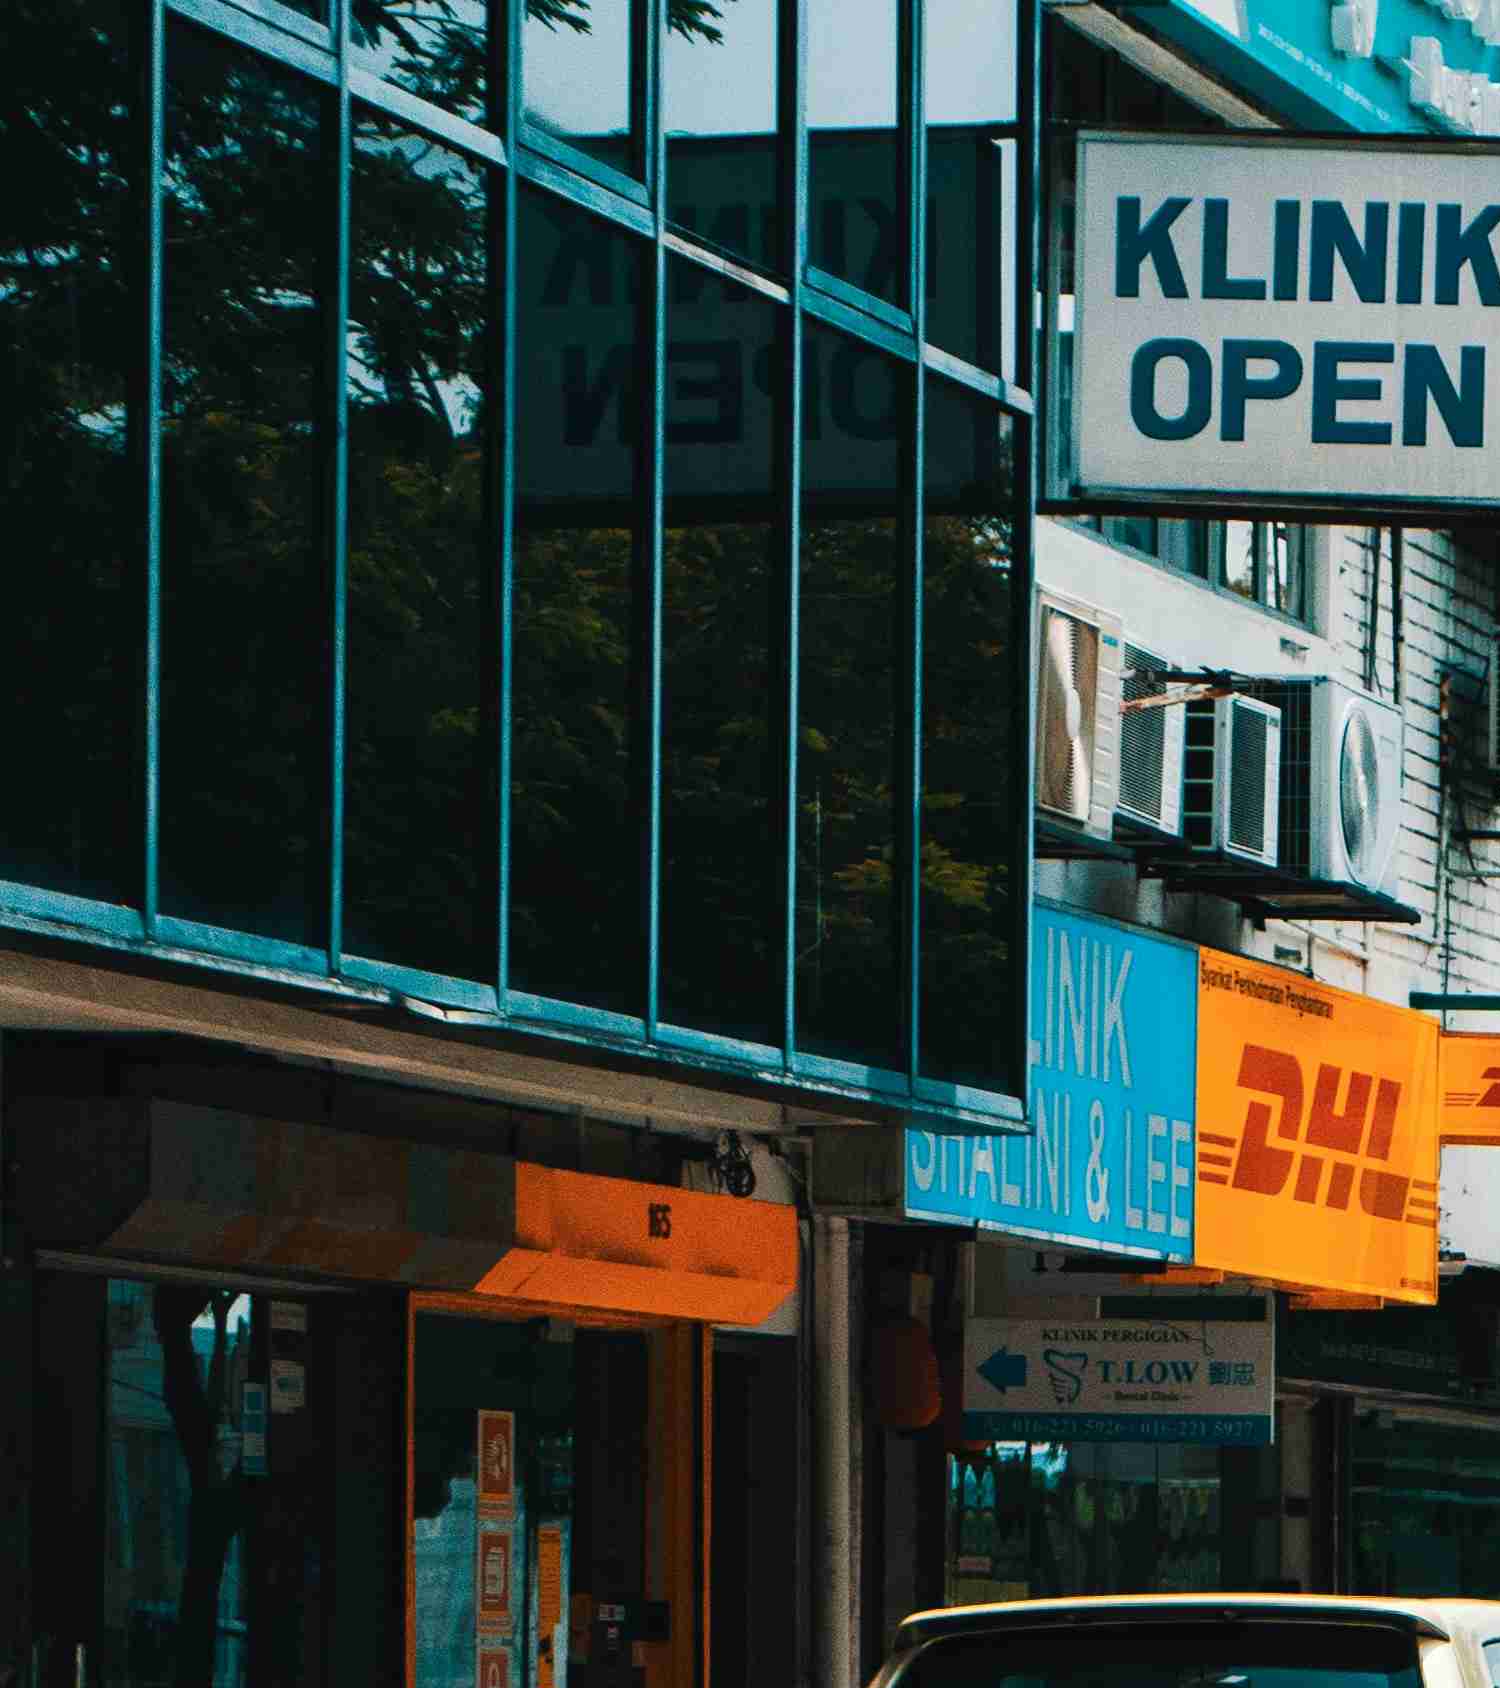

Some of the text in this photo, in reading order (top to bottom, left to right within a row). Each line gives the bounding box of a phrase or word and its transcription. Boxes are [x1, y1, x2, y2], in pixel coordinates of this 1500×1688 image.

[1129, 336, 1487, 449] OPEN
[1085, 1099, 1110, 1224] &
[1124, 1106, 1192, 1238] LEE
[1231, 1043, 1410, 1222] DHL
